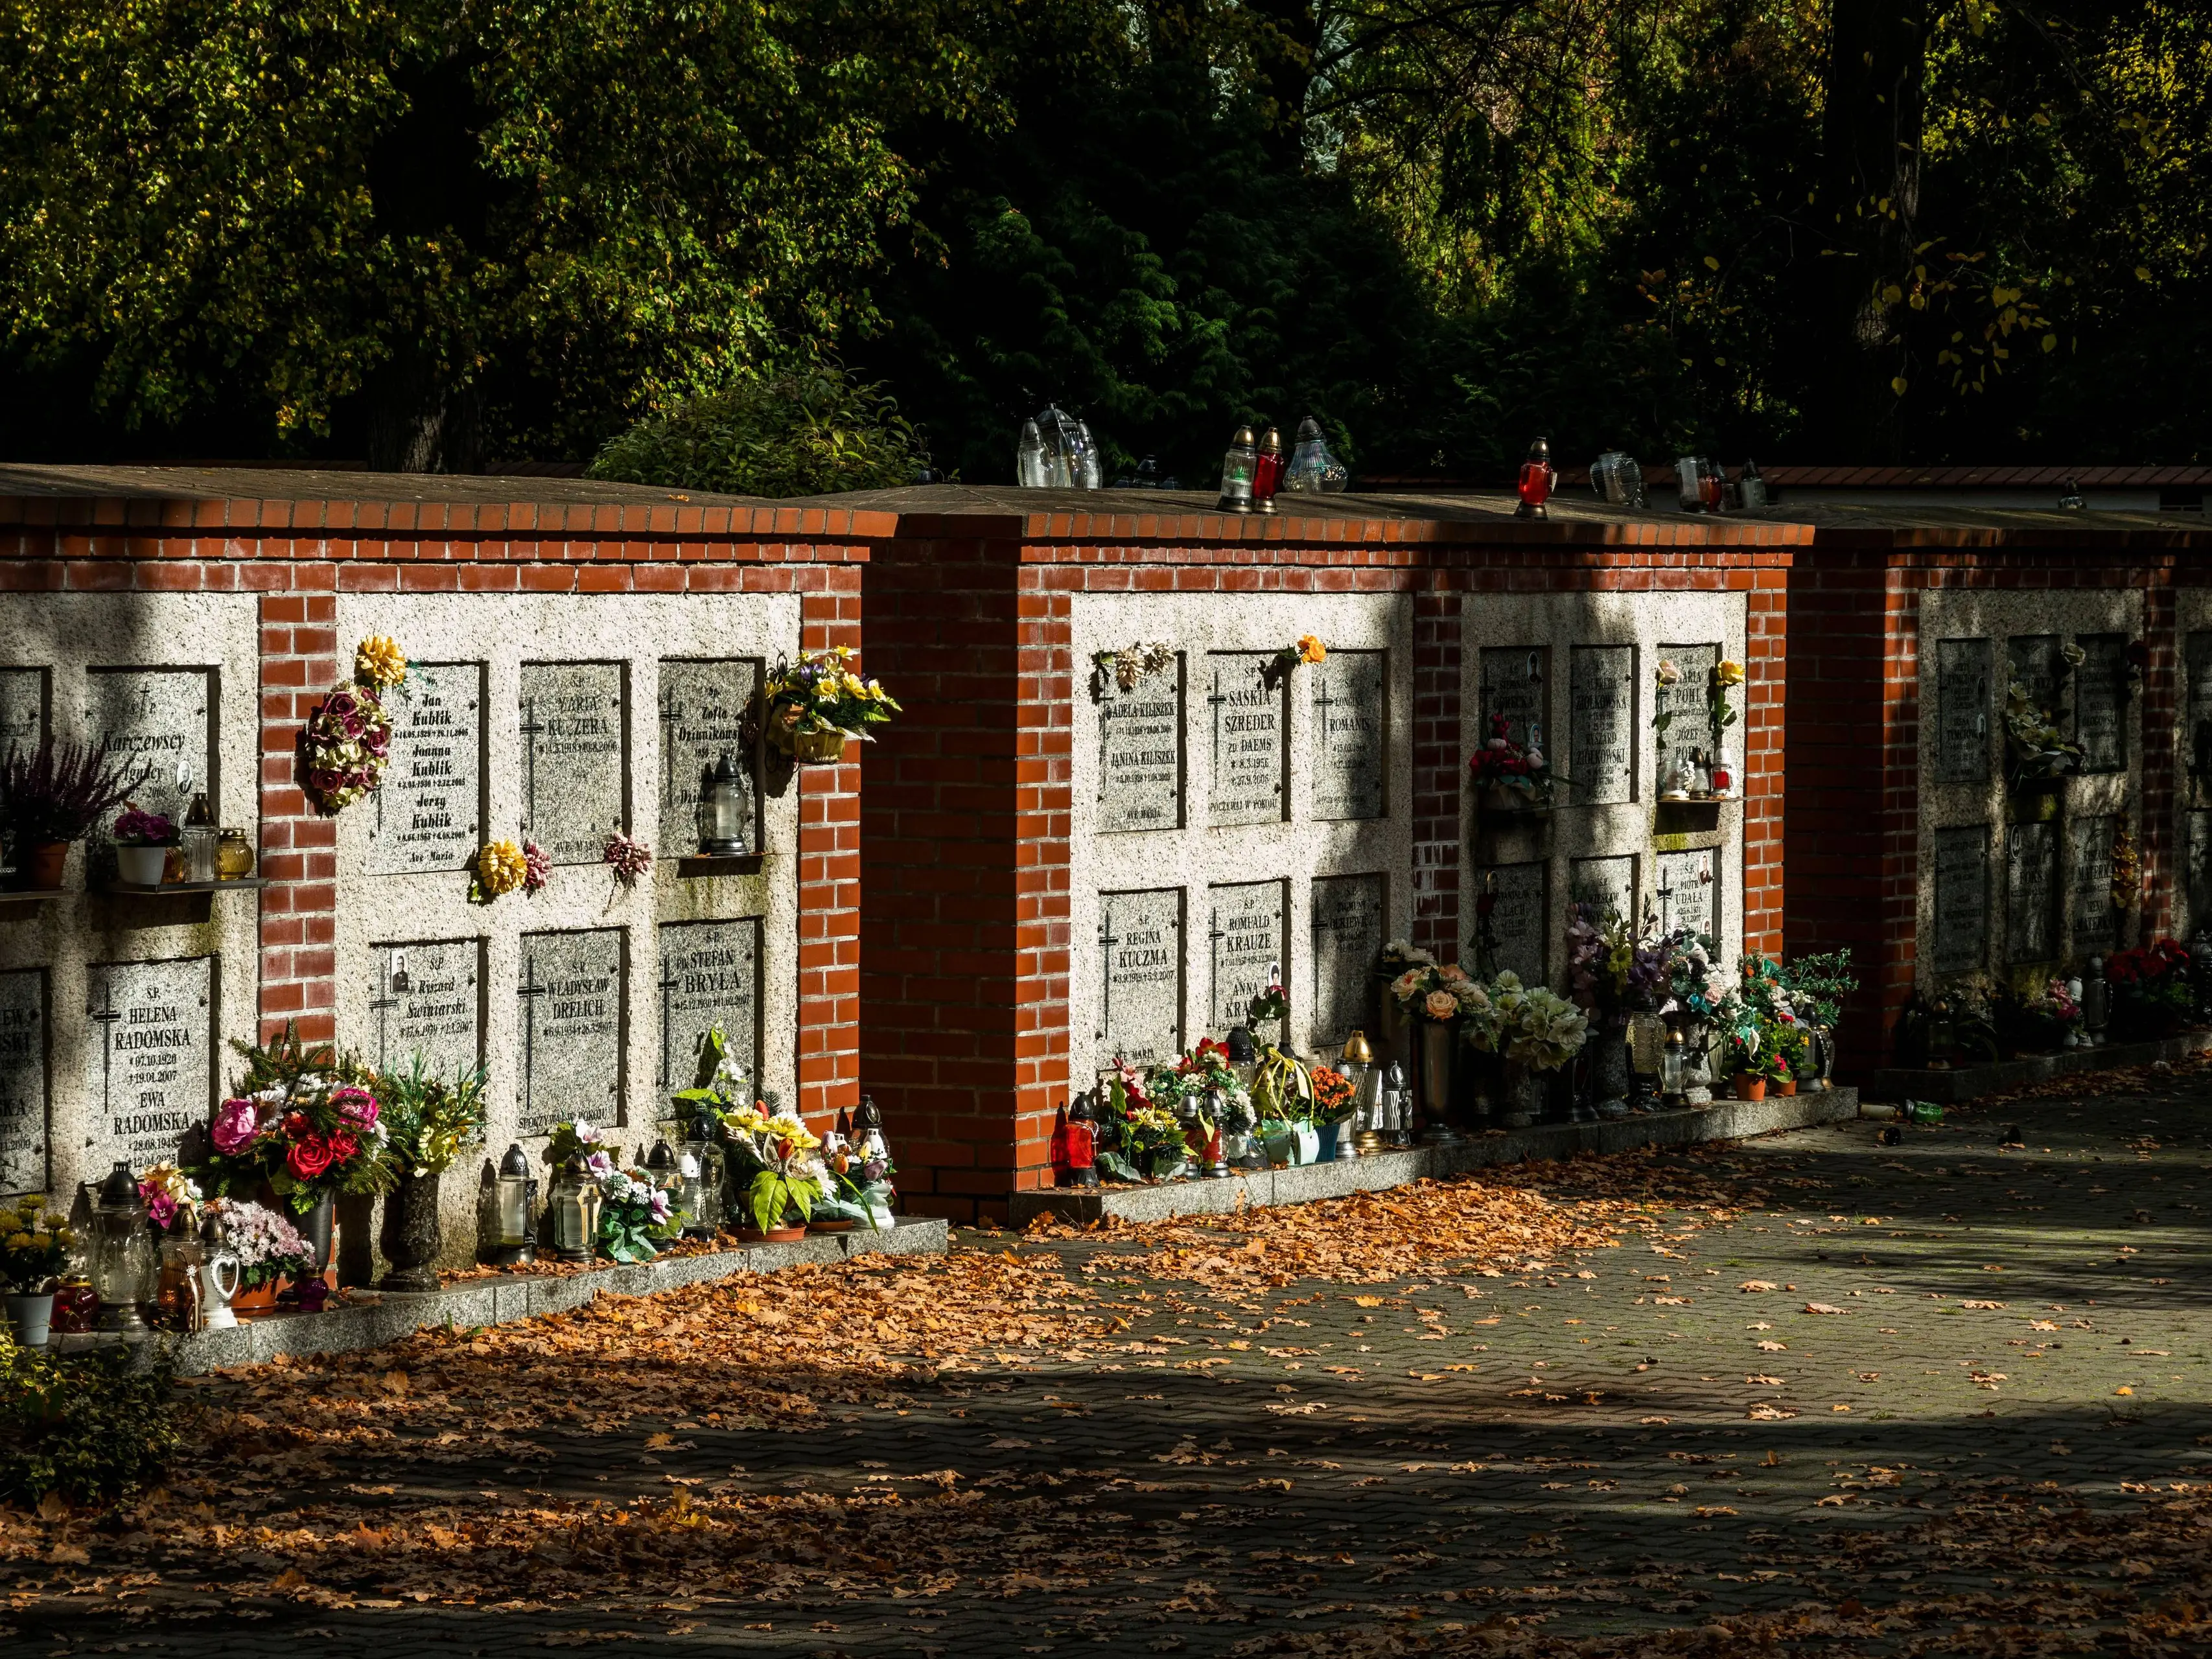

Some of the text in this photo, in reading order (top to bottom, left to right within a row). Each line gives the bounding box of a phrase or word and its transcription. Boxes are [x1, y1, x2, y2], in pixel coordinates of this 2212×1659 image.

[422, 693, 441, 707] Jan
[1229, 690, 1272, 707] SASKIA
[1675, 688, 1702, 704] POHL
[701, 706, 727, 721] Zofia
[1112, 702, 1176, 718] ADELA KILISZEK
[412, 712, 452, 726] Kublik
[1225, 714, 1275, 733] SZREDER
[1330, 717, 1370, 732] ROMANIS
[103, 731, 185, 752] Karczewscy
[1241, 737, 1272, 752] DAEMS
[412, 745, 451, 758] Joanna
[1111, 750, 1176, 767] JANINA KILISZEK
[123, 766, 164, 784] Igncy
[412, 761, 452, 777] Kublik
[417, 793, 446, 810] Jerzy
[412, 813, 452, 830] Kublik
[1680, 879, 1699, 890] PIOTR
[1229, 915, 1270, 931] ROMUALD
[1126, 931, 1161, 946] REGINA
[1227, 933, 1272, 953] KRAUZE
[690, 949, 735, 969] STEFAN
[1119, 949, 1168, 968] KUCZMA
[419, 977, 455, 995] Ryszard
[684, 970, 741, 993] BRYŁA
[1233, 982, 1259, 997] ANNA
[129, 1006, 177, 1025] HELENA
[553, 999, 605, 1019] DRELICH
[115, 1028, 191, 1050] RADOMSKA
[135, 1054, 178, 1068] 07.10.1920
[135, 1071, 178, 1084] 19.01.2007
[139, 1091, 165, 1108] EWA
[113, 1112, 190, 1135] RADOMSKA
